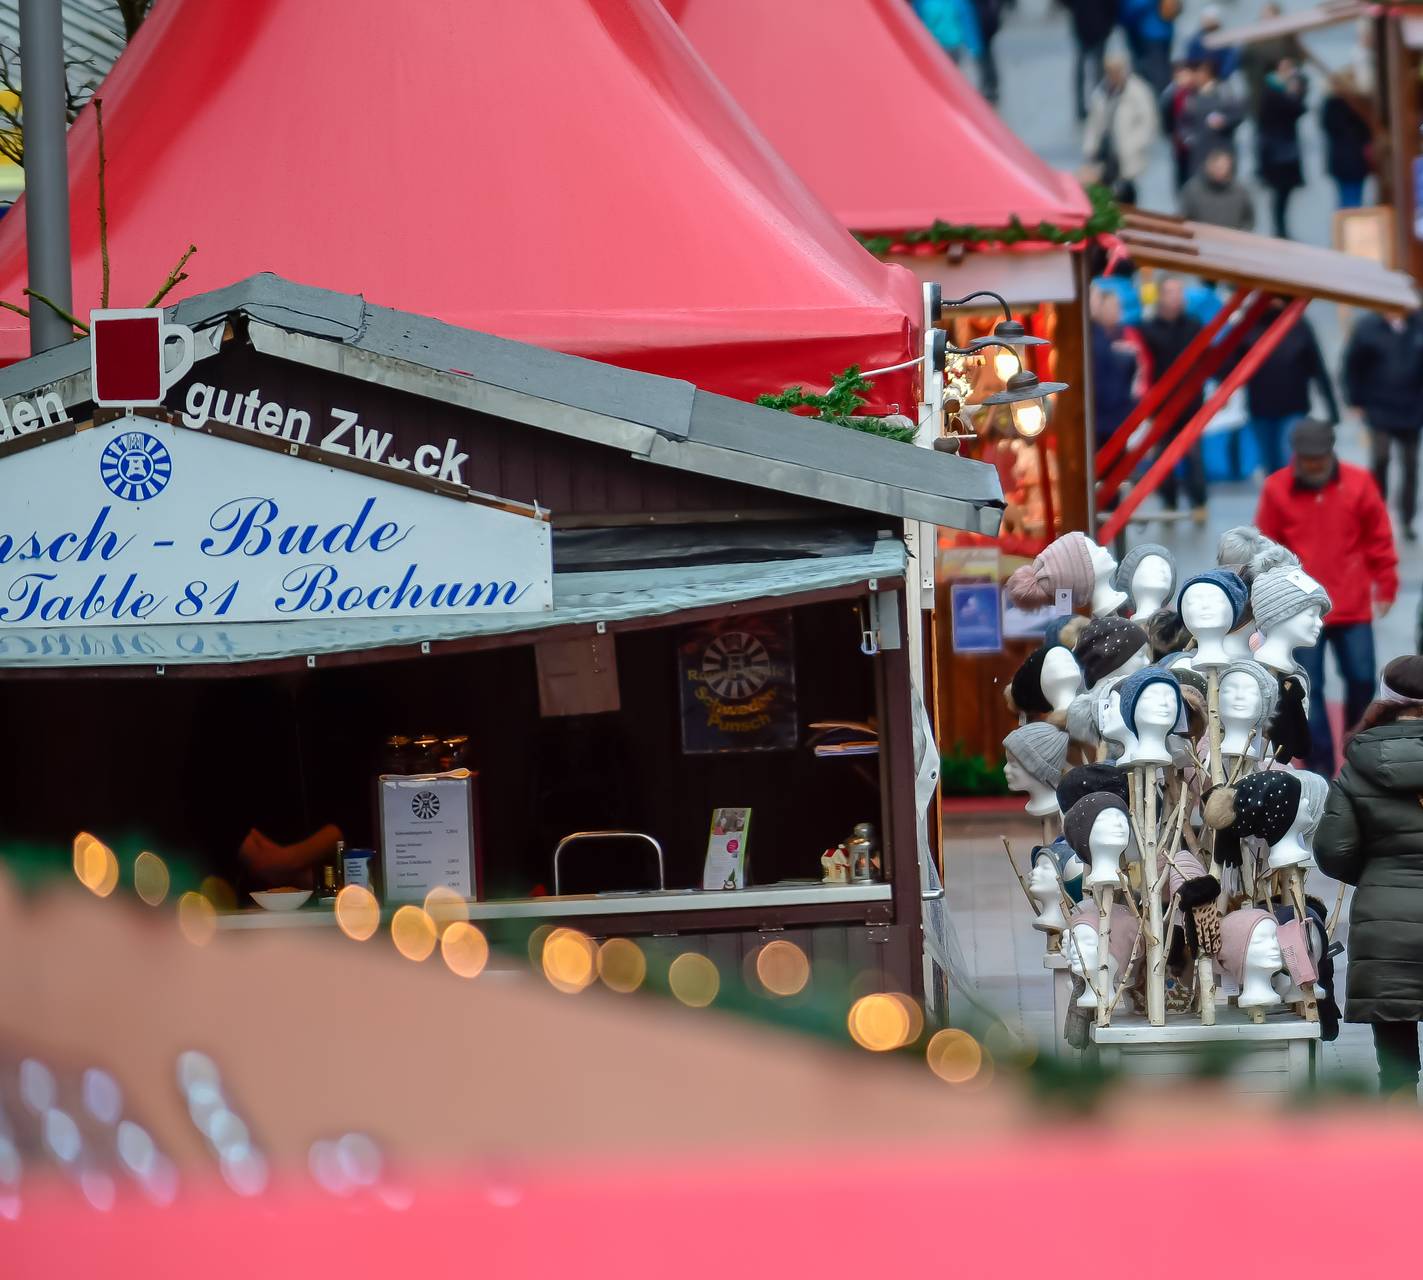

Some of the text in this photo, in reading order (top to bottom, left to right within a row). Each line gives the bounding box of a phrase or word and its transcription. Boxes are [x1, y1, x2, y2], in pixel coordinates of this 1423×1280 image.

[182, 382, 470, 484] guten Zwck
[200, 496, 415, 556] Bude
[0, 563, 531, 622] Table 81 Bochum
